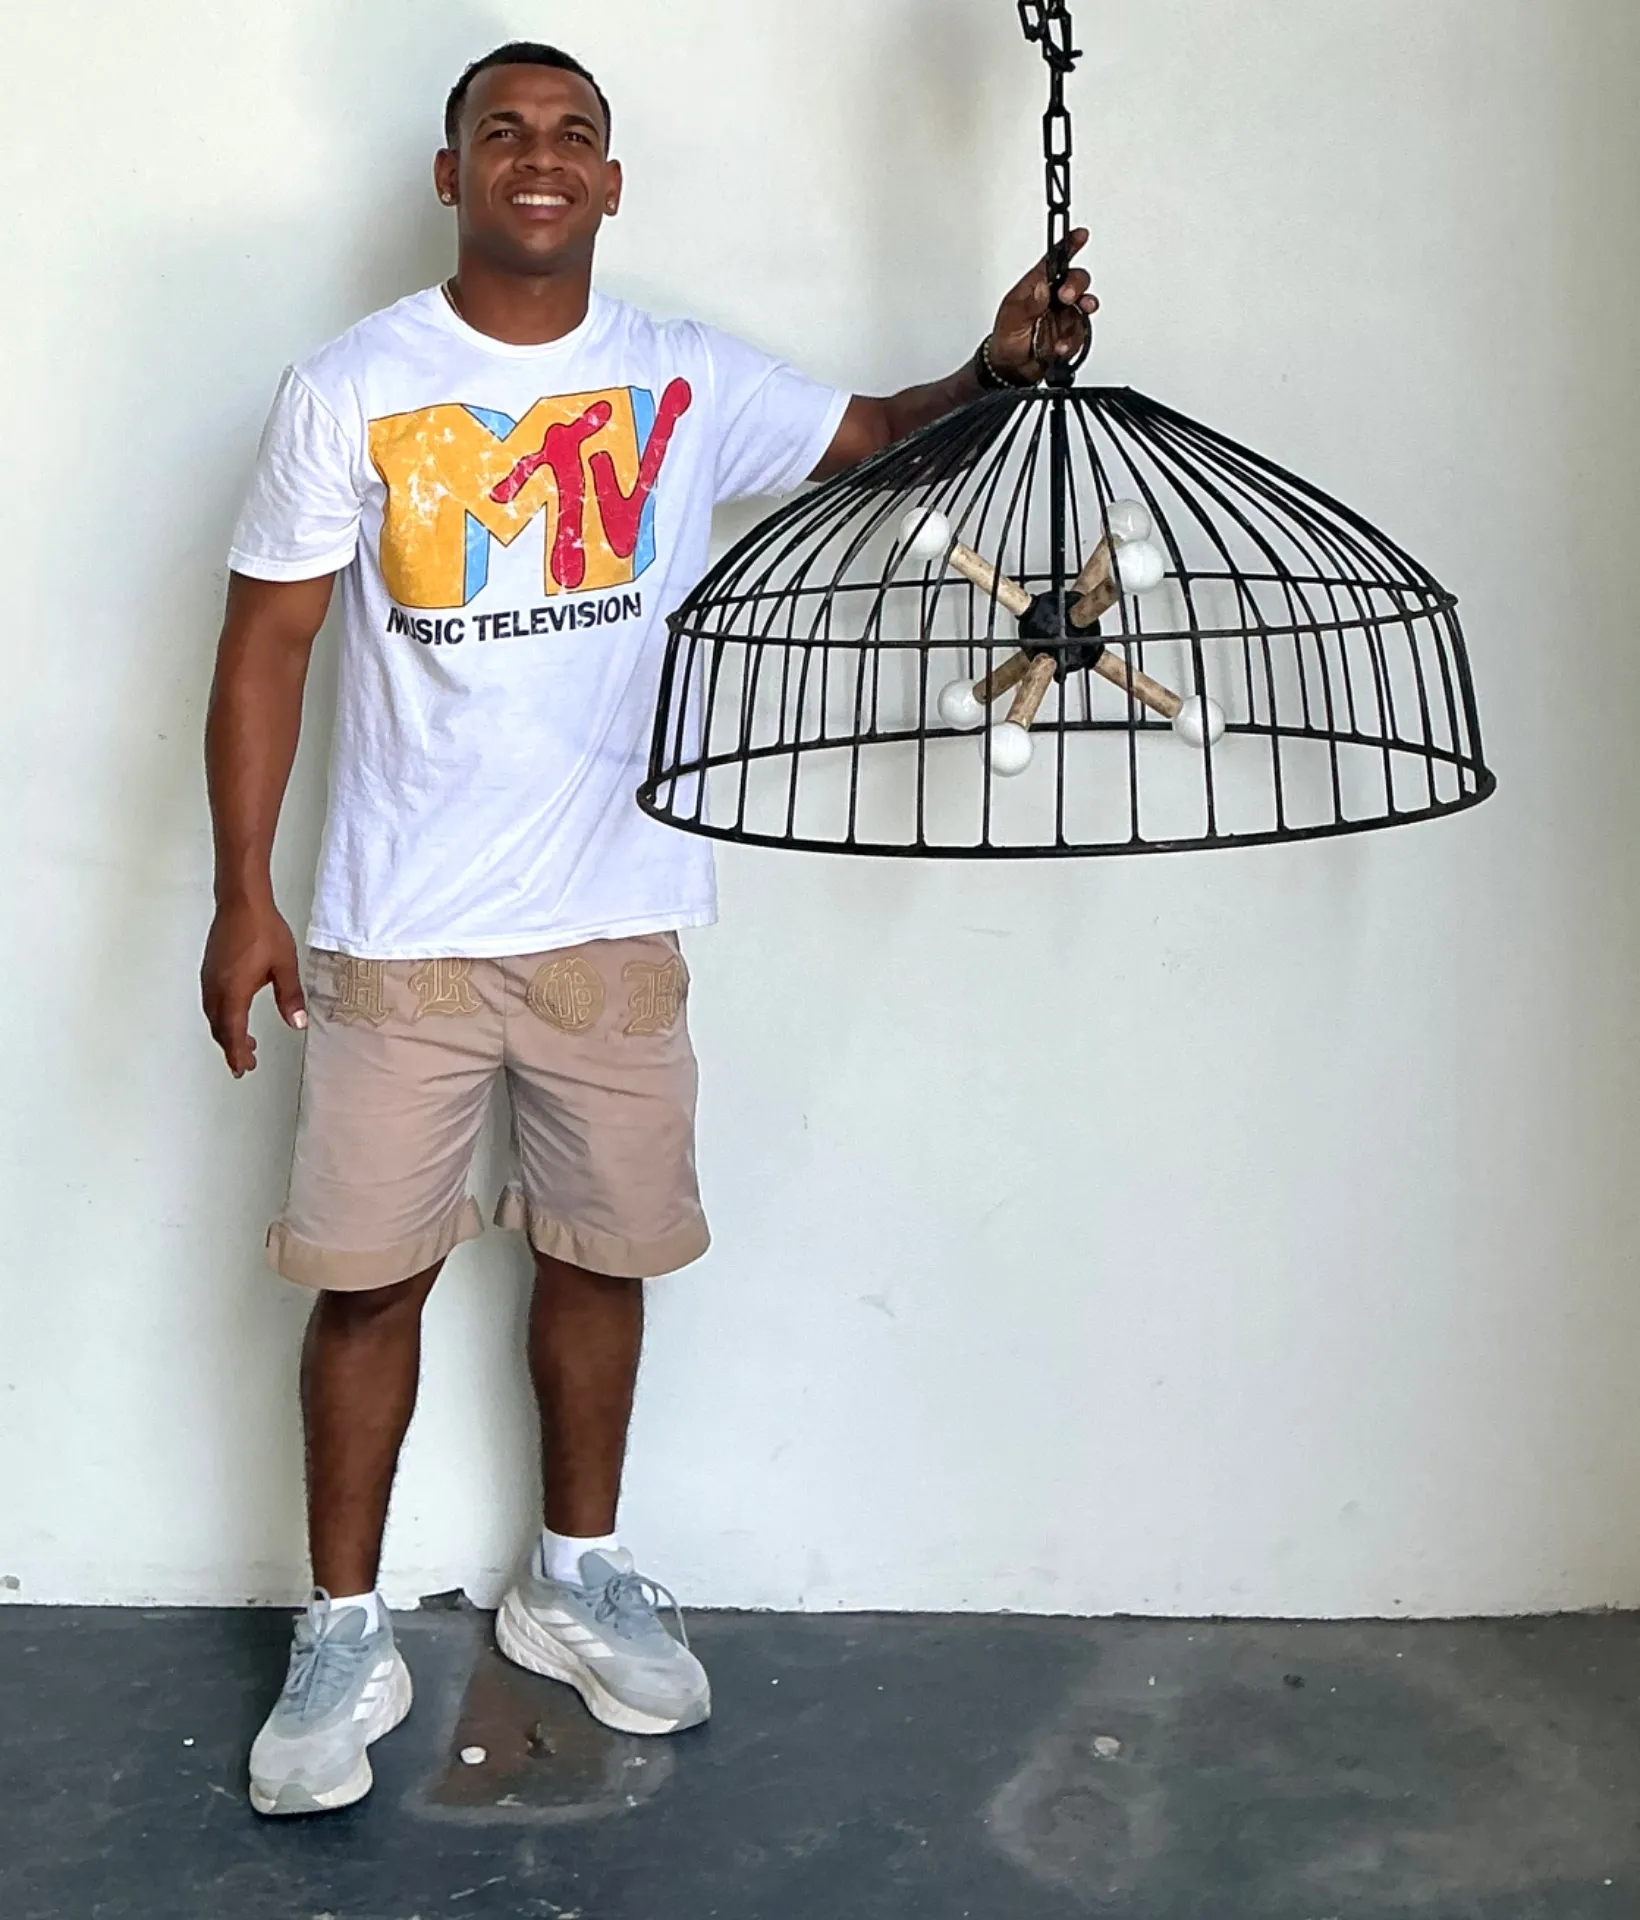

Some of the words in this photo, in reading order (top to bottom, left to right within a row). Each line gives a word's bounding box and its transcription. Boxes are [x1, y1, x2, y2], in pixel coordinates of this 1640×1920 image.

[368, 377, 692, 609] MTV
[386, 606, 465, 646] MUSIC
[472, 591, 642, 642] TELEVISION
